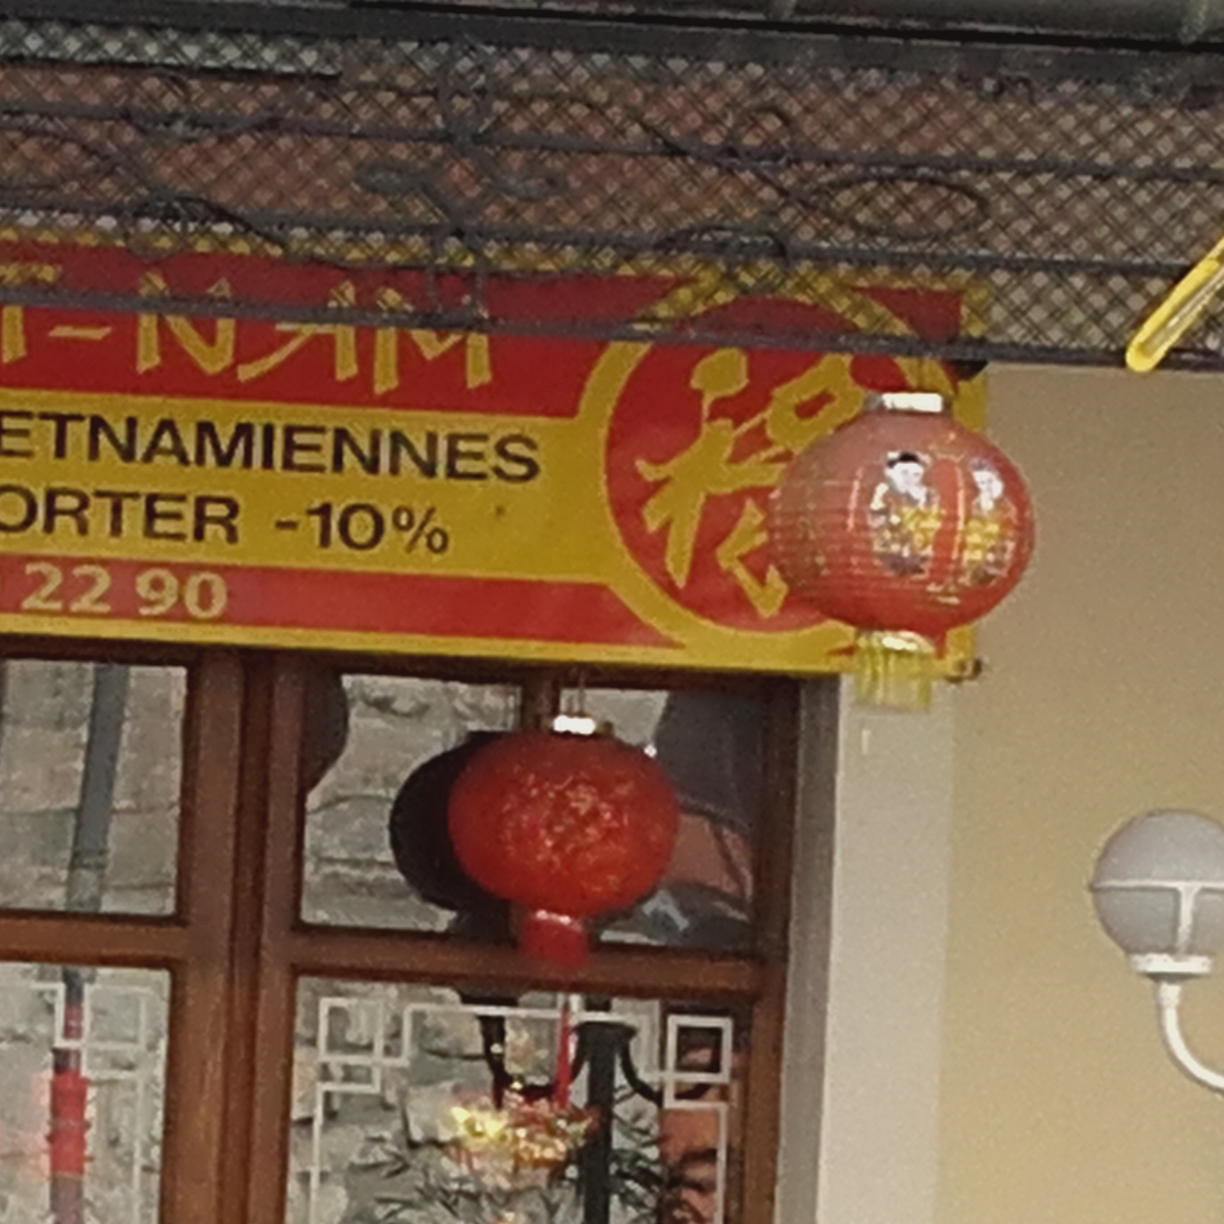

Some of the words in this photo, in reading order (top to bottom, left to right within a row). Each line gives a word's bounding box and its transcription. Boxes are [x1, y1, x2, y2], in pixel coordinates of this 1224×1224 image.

[274, 503, 450, 555] -10%
[22, 565, 114, 614] 22
[136, 569, 228, 619] 90
